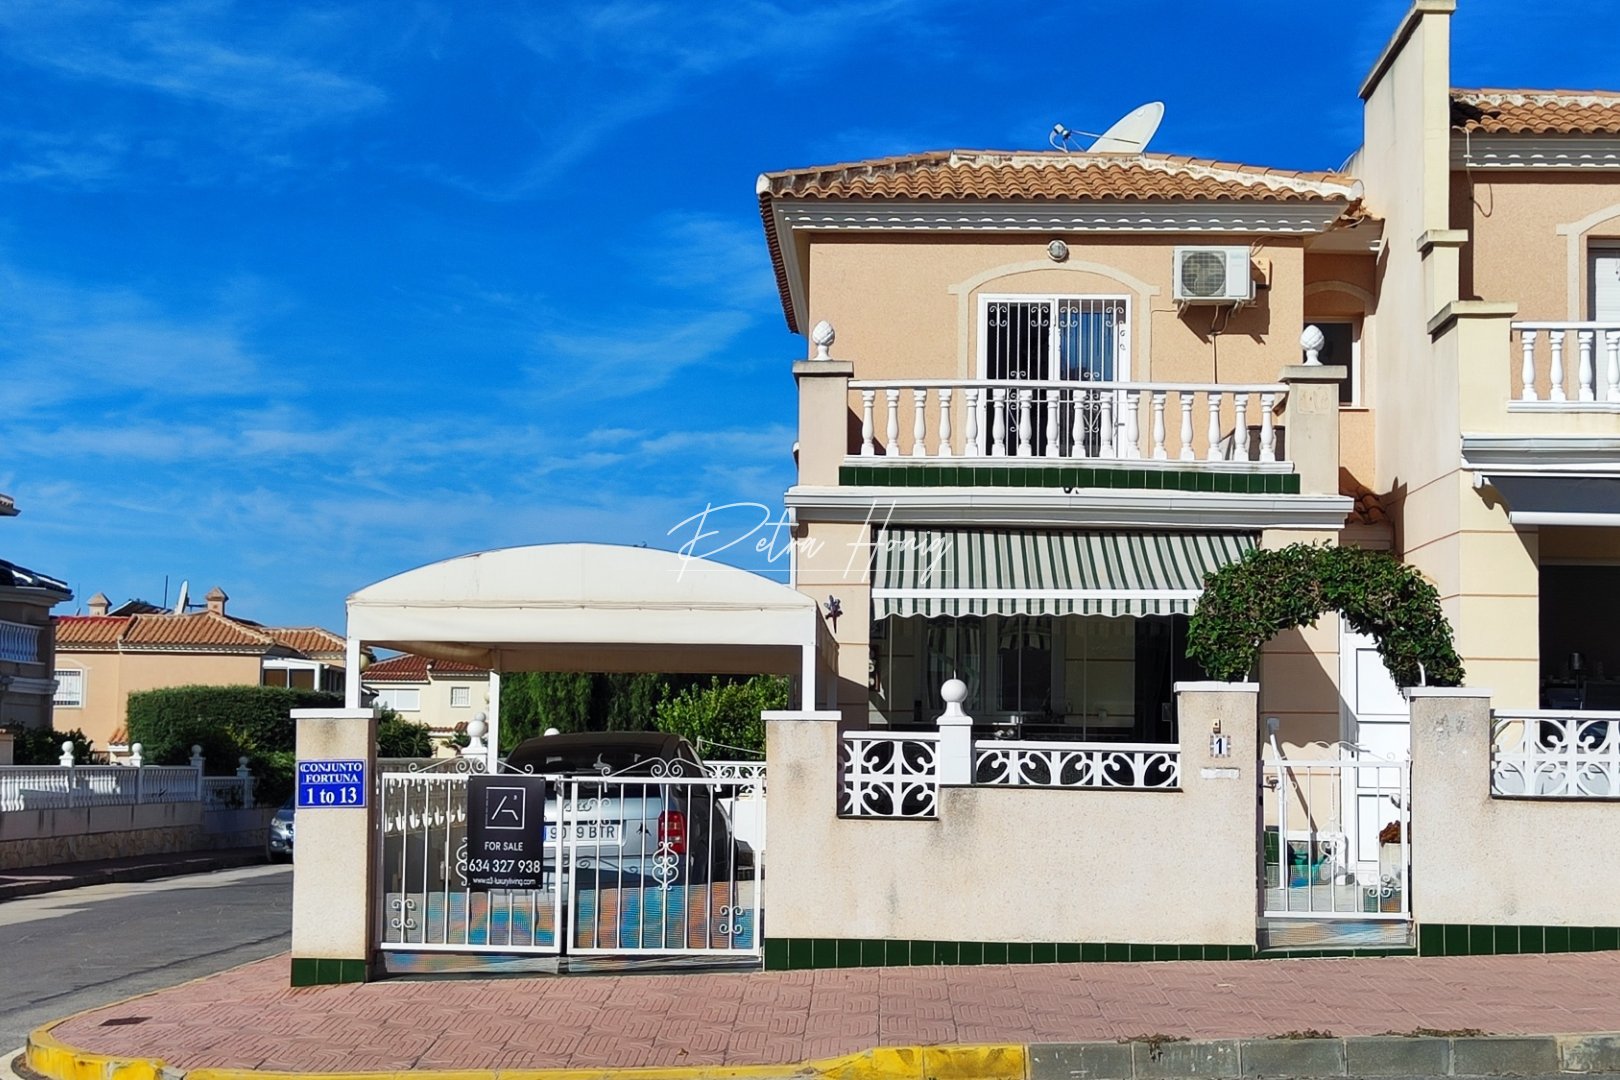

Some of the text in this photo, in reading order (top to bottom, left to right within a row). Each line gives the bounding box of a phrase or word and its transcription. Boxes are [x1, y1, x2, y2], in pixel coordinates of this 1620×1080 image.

[1215, 737, 1222, 754] 1
[300, 762, 362, 772] CONJUNTO
[306, 774, 359, 783] FORTUNA
[306, 787, 357, 804] 1 to 13
[589, 825, 615, 839] BTR
[484, 841, 523, 851] FOR SALE
[468, 859, 541, 873] 634 327 938
